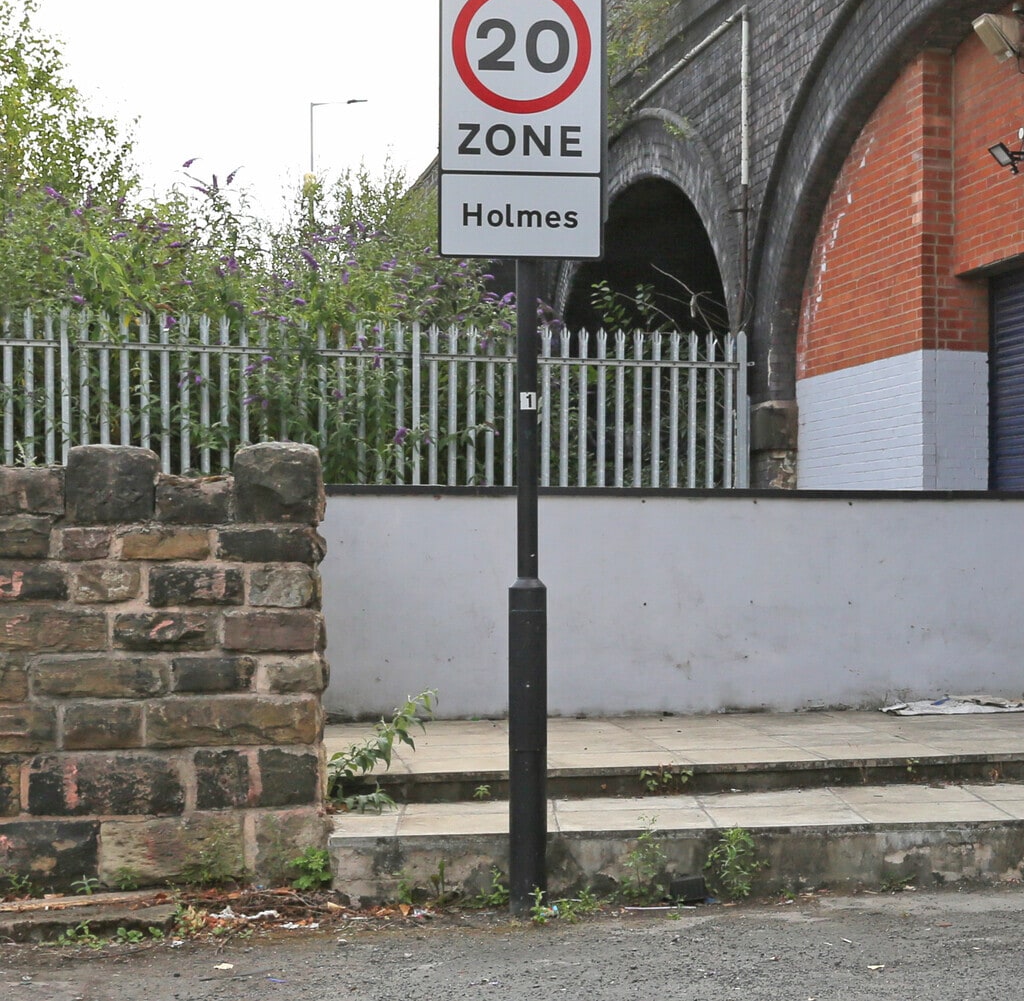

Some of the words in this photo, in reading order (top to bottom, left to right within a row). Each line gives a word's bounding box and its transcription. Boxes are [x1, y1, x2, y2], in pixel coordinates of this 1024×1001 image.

[476, 18, 570, 73] 20
[458, 123, 582, 157] ZONE
[463, 203, 579, 229] Holmes
[526, 394, 532, 408] 1
